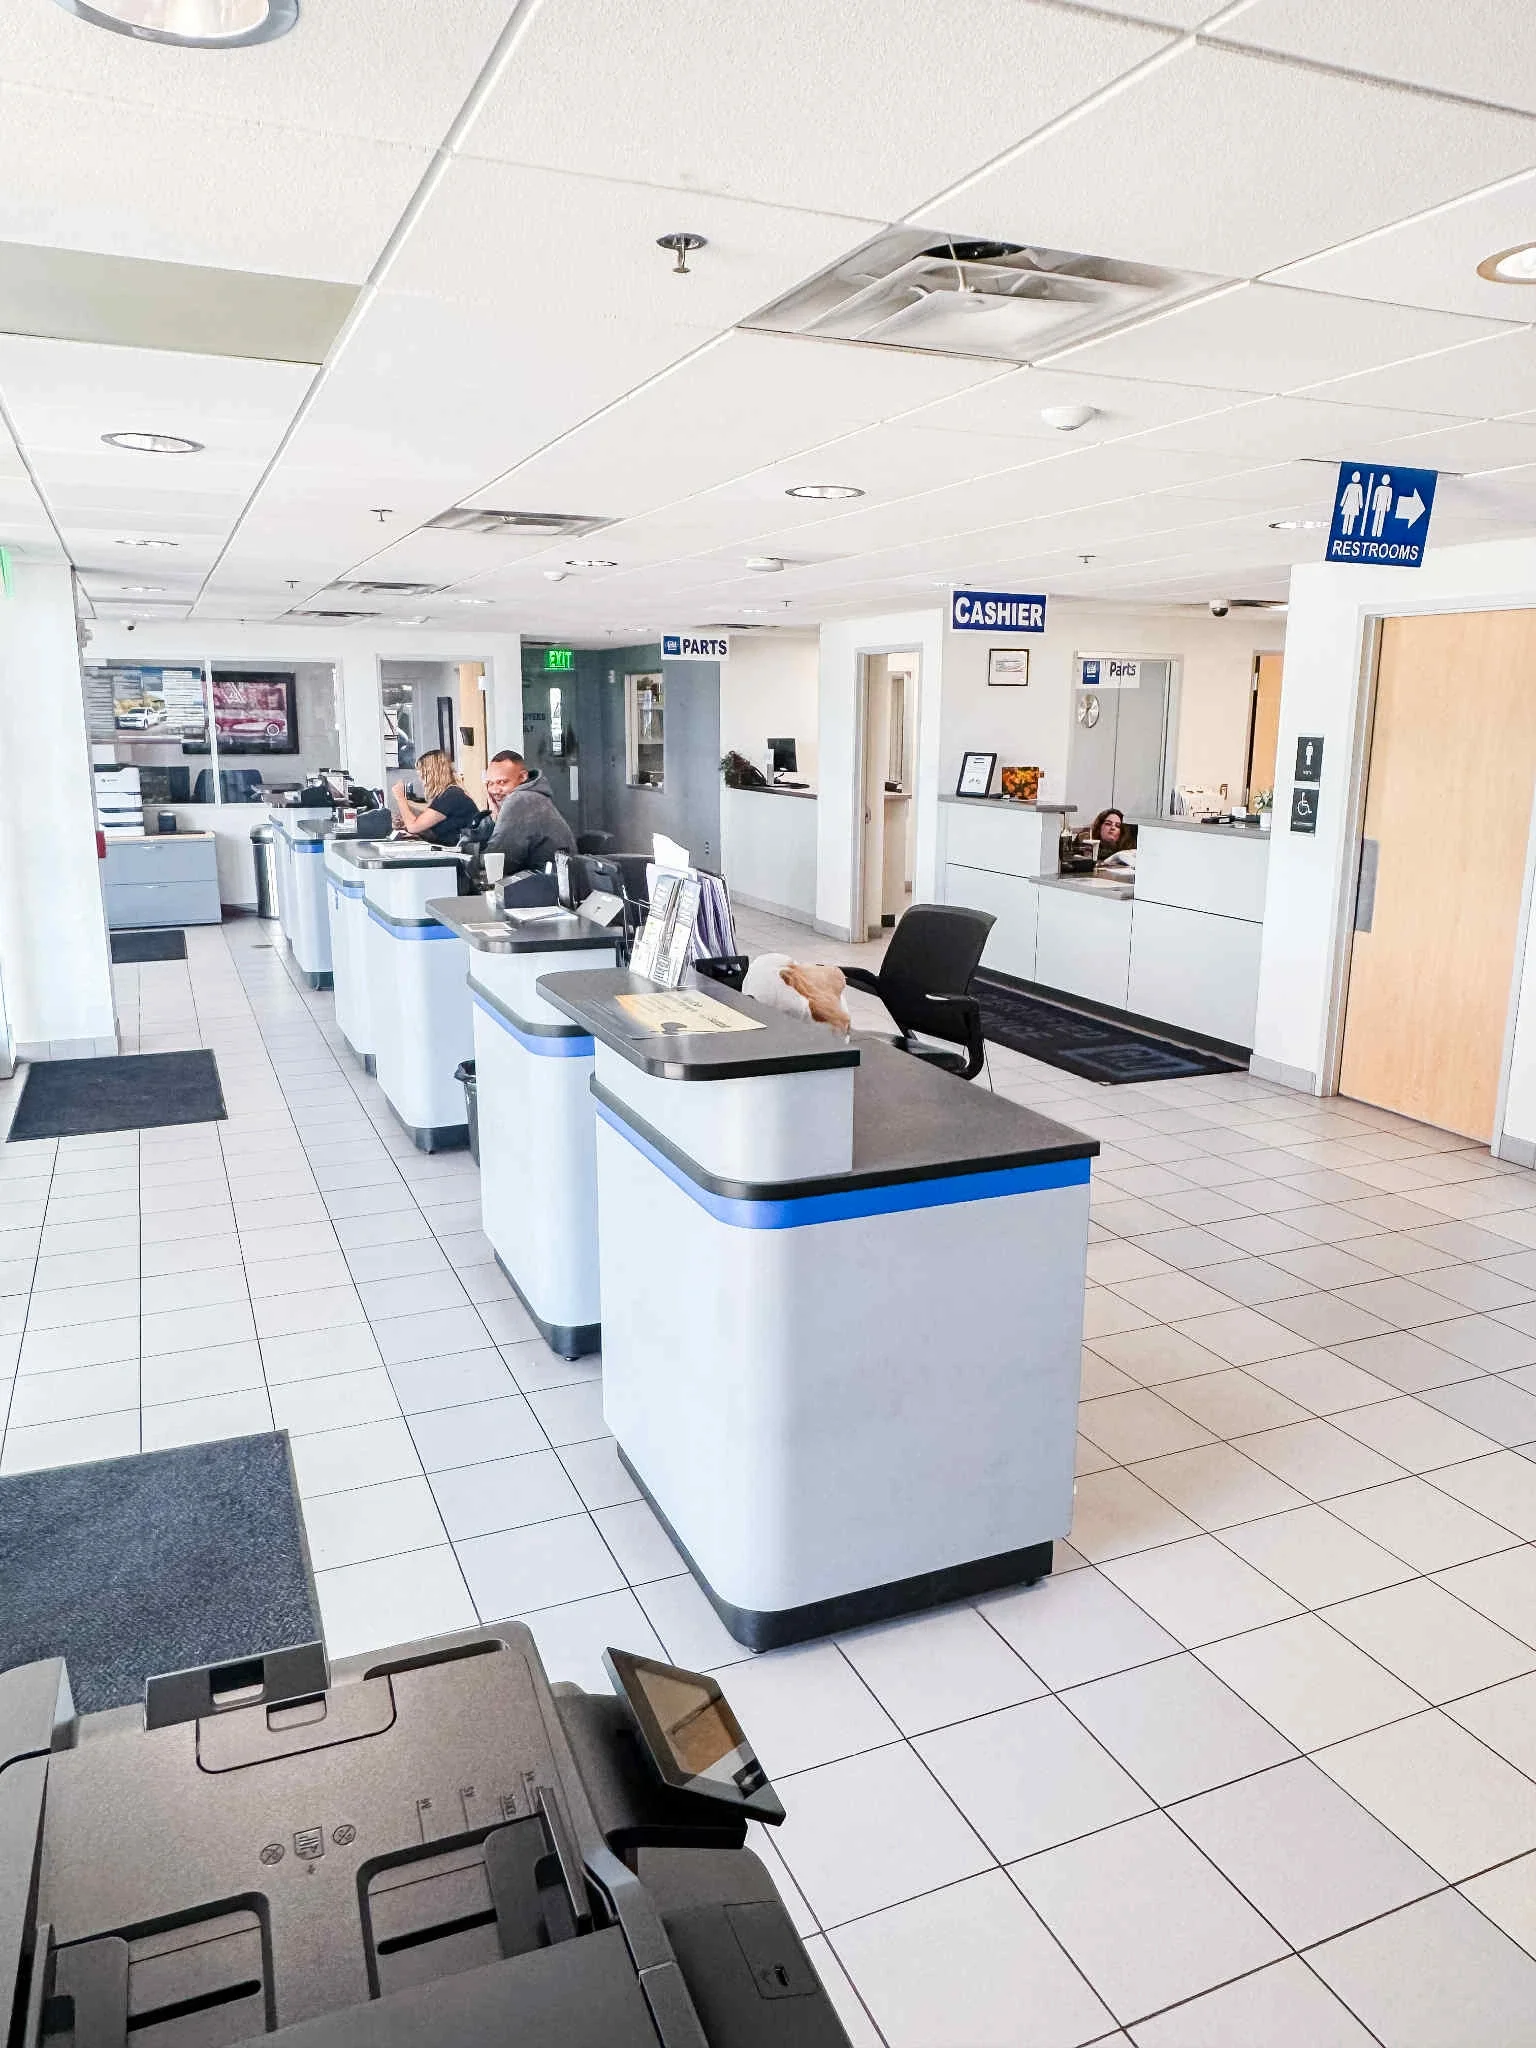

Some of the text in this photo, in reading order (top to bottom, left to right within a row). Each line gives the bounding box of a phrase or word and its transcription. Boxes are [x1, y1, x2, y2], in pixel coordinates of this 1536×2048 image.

[1332, 540, 1419, 560] RESTROOMS
[955, 597, 1043, 627] CASHIER
[682, 638, 727, 655] PARTS
[549, 650, 572, 668] EXIT
[1109, 661, 1136, 677] Parts
